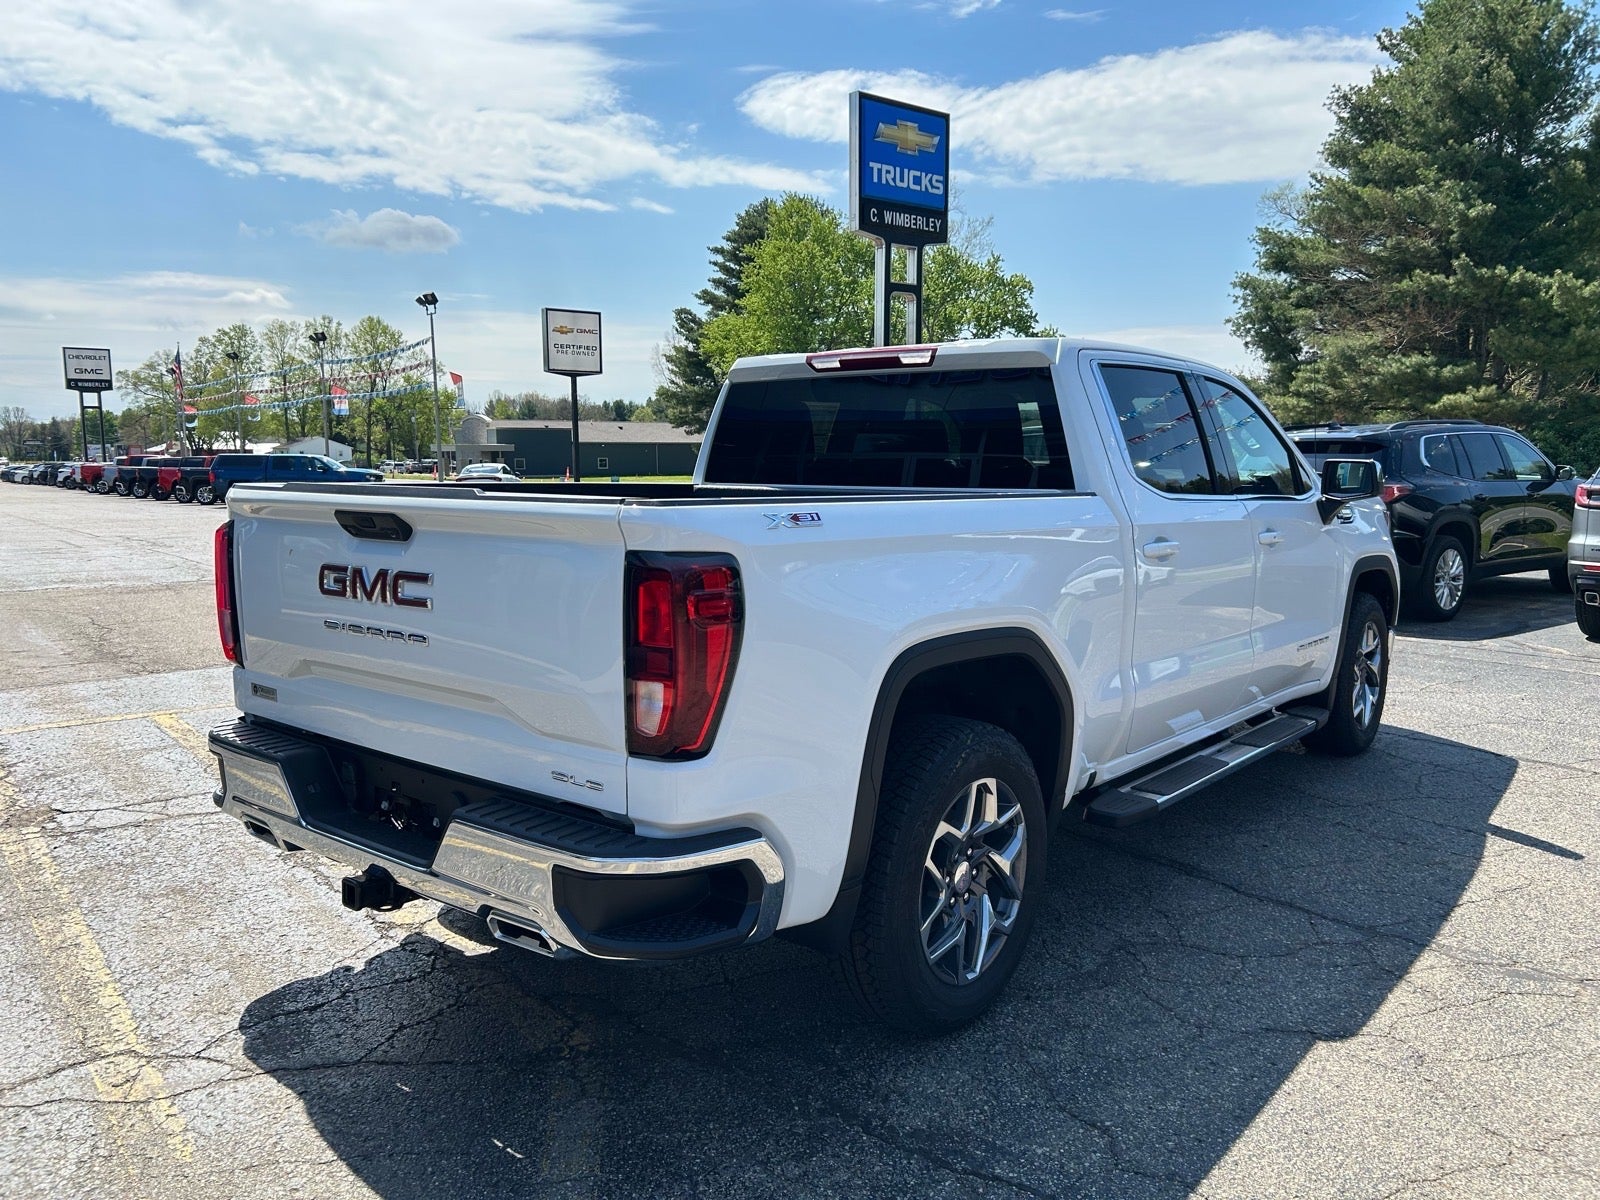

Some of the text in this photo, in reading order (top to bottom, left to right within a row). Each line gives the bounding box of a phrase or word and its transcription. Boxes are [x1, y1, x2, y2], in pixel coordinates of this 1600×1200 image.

[869, 161, 944, 195] TRUCKS
[870, 208, 942, 233] C. WIMBERLEY
[553, 343, 598, 352] CERTIFIED
[74, 367, 104, 375] GMC
[319, 563, 434, 611] GMC
[323, 619, 430, 648] SIERRA
